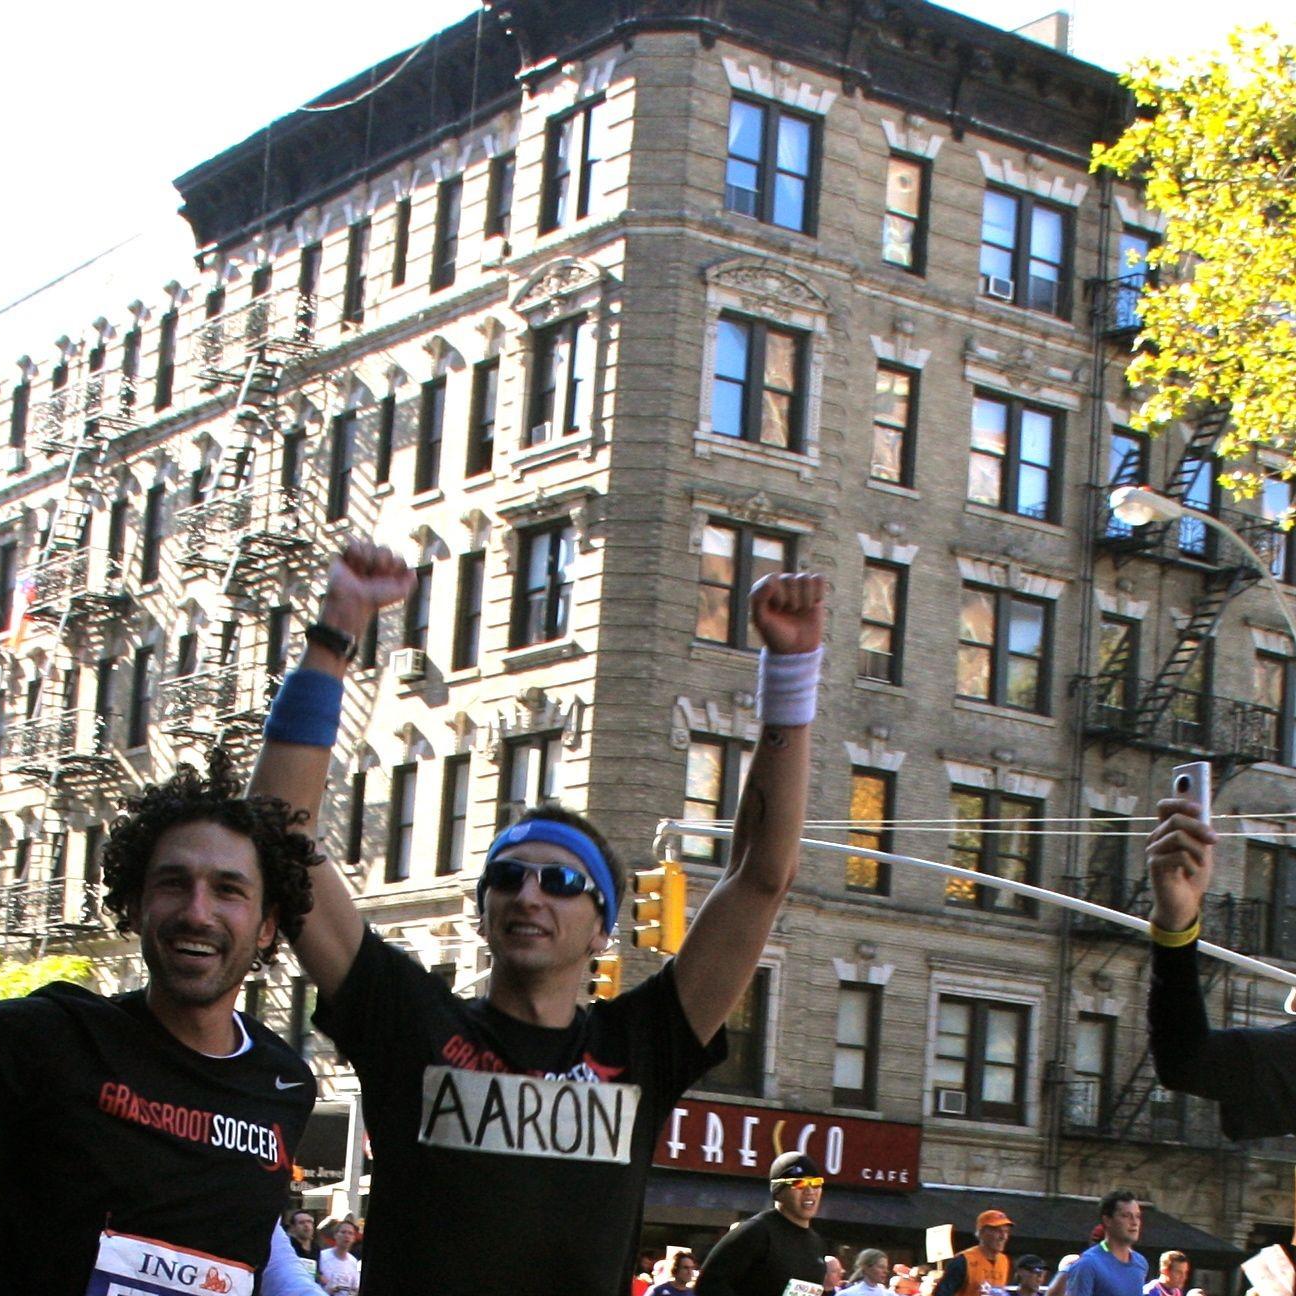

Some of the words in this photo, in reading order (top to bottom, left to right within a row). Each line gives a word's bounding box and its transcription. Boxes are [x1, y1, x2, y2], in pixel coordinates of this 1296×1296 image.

[424, 1071, 622, 1157] AARON
[861, 1167, 909, 1184] CAFÉ
[139, 1252, 198, 1286] ING
